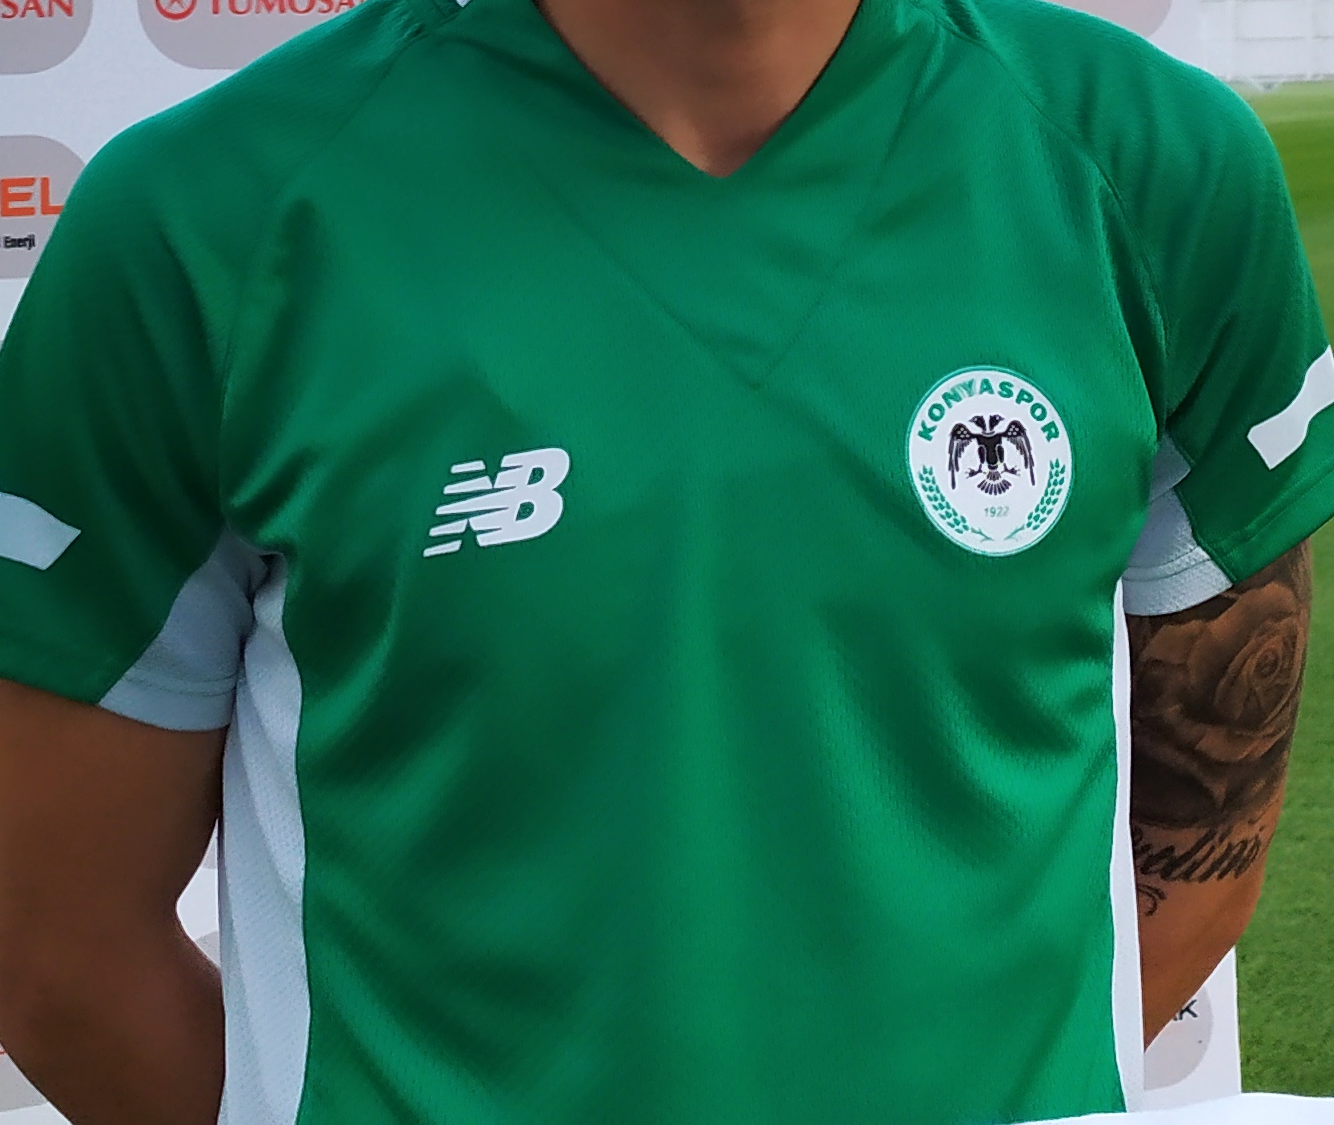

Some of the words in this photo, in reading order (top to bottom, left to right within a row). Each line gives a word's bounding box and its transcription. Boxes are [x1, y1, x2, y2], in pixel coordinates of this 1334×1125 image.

[3, 234, 36, 250] Enerji
[918, 378, 1061, 443] KONYASPOR
[984, 505, 1010, 518] 1922
